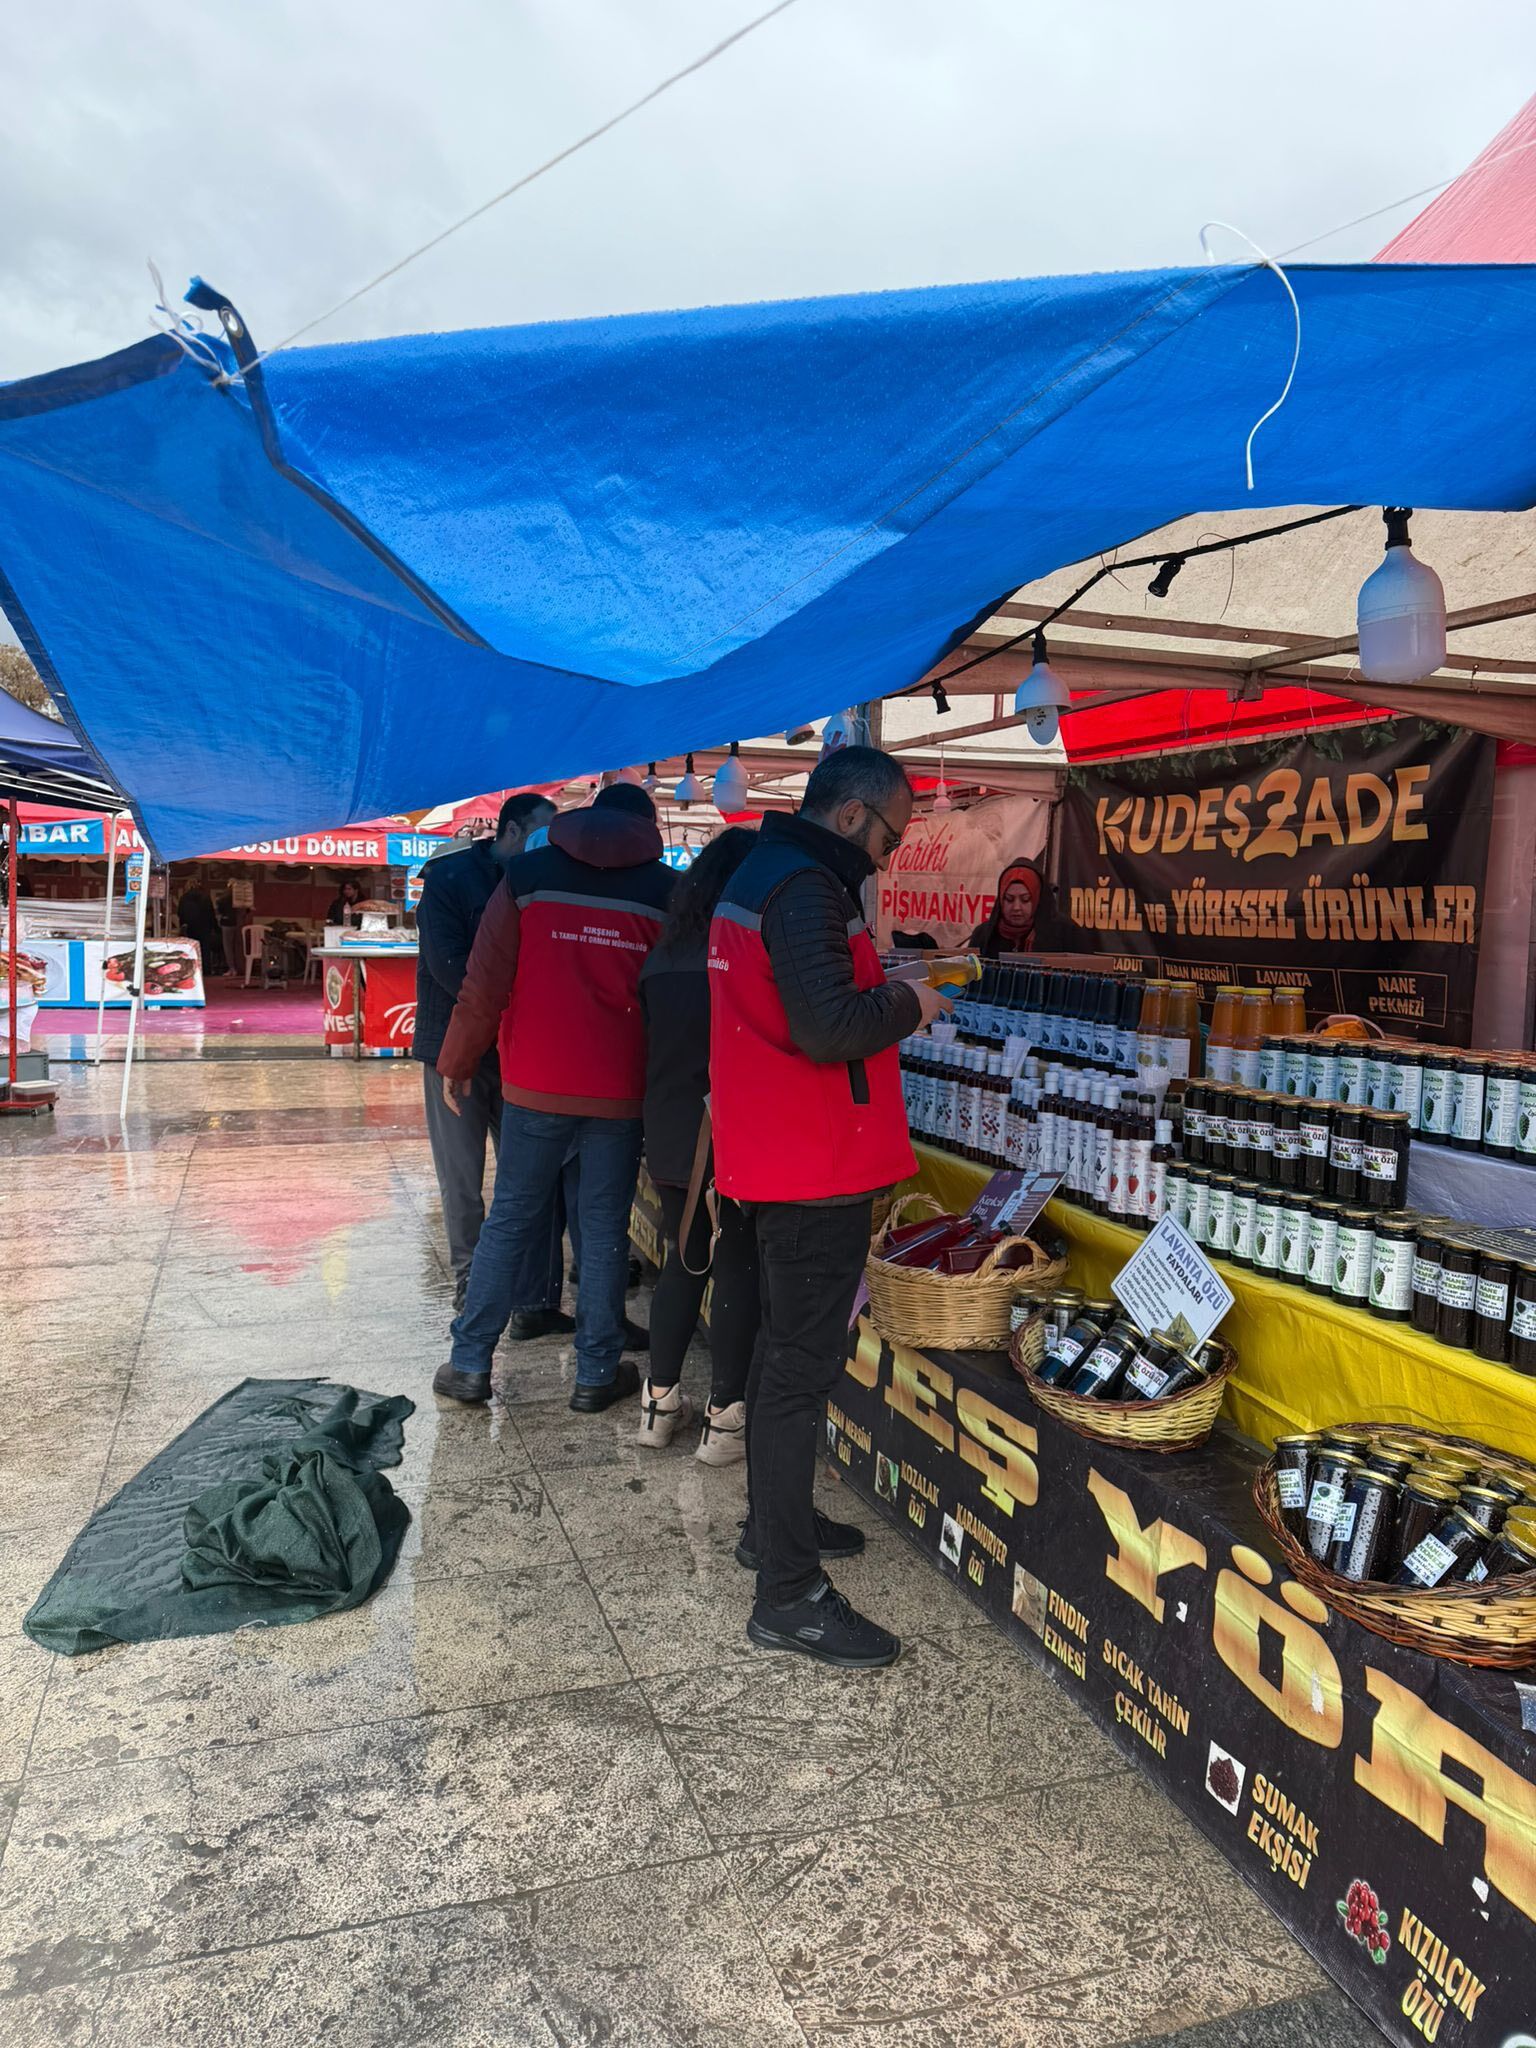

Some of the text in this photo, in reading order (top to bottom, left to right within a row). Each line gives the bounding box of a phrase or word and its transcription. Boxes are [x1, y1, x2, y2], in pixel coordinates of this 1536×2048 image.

[306, 835, 379, 858] DÖNER
[881, 881, 997, 925] PİŞMANİYE
[1069, 873, 1478, 945] DOĞAL ve YÖRESEL ÜRÜNLER
[559, 932, 578, 942] TARIM
[588, 936, 611, 947] ORMAN
[583, 926, 621, 939] KIRŞEHİR
[1191, 965, 1231, 984] MERSİNİ
[1255, 970, 1313, 989] LAVANTA
[1378, 976, 1417, 996] NANE
[1368, 994, 1425, 1019] PEKMEZİ
[1160, 1225, 1226, 1311] LAVANTA ÖZÜ
[1165, 1253, 1204, 1305] FAYDALARI
[838, 1437, 852, 1467] ÖZÜ
[844, 1416, 872, 1455] MERSİNİ
[901, 1459, 940, 1508] KOZALAK
[908, 1493, 927, 1529] ÖZÜ
[968, 1550, 985, 1587] ÖZÜ
[1048, 1588, 1090, 1644] FINDIK
[1043, 1624, 1087, 1681] EZMESİ
[1102, 1638, 1191, 1737] SICAK TAHİN
[1115, 1690, 1167, 1760] ÇEKİLİR
[1252, 1772, 1320, 1858] SUMAK
[1246, 1815, 1311, 1891] EKŞİSİ
[1398, 1906, 1487, 2022] KIZILCIK
[1401, 1968, 1449, 2044] ÖZÜ
